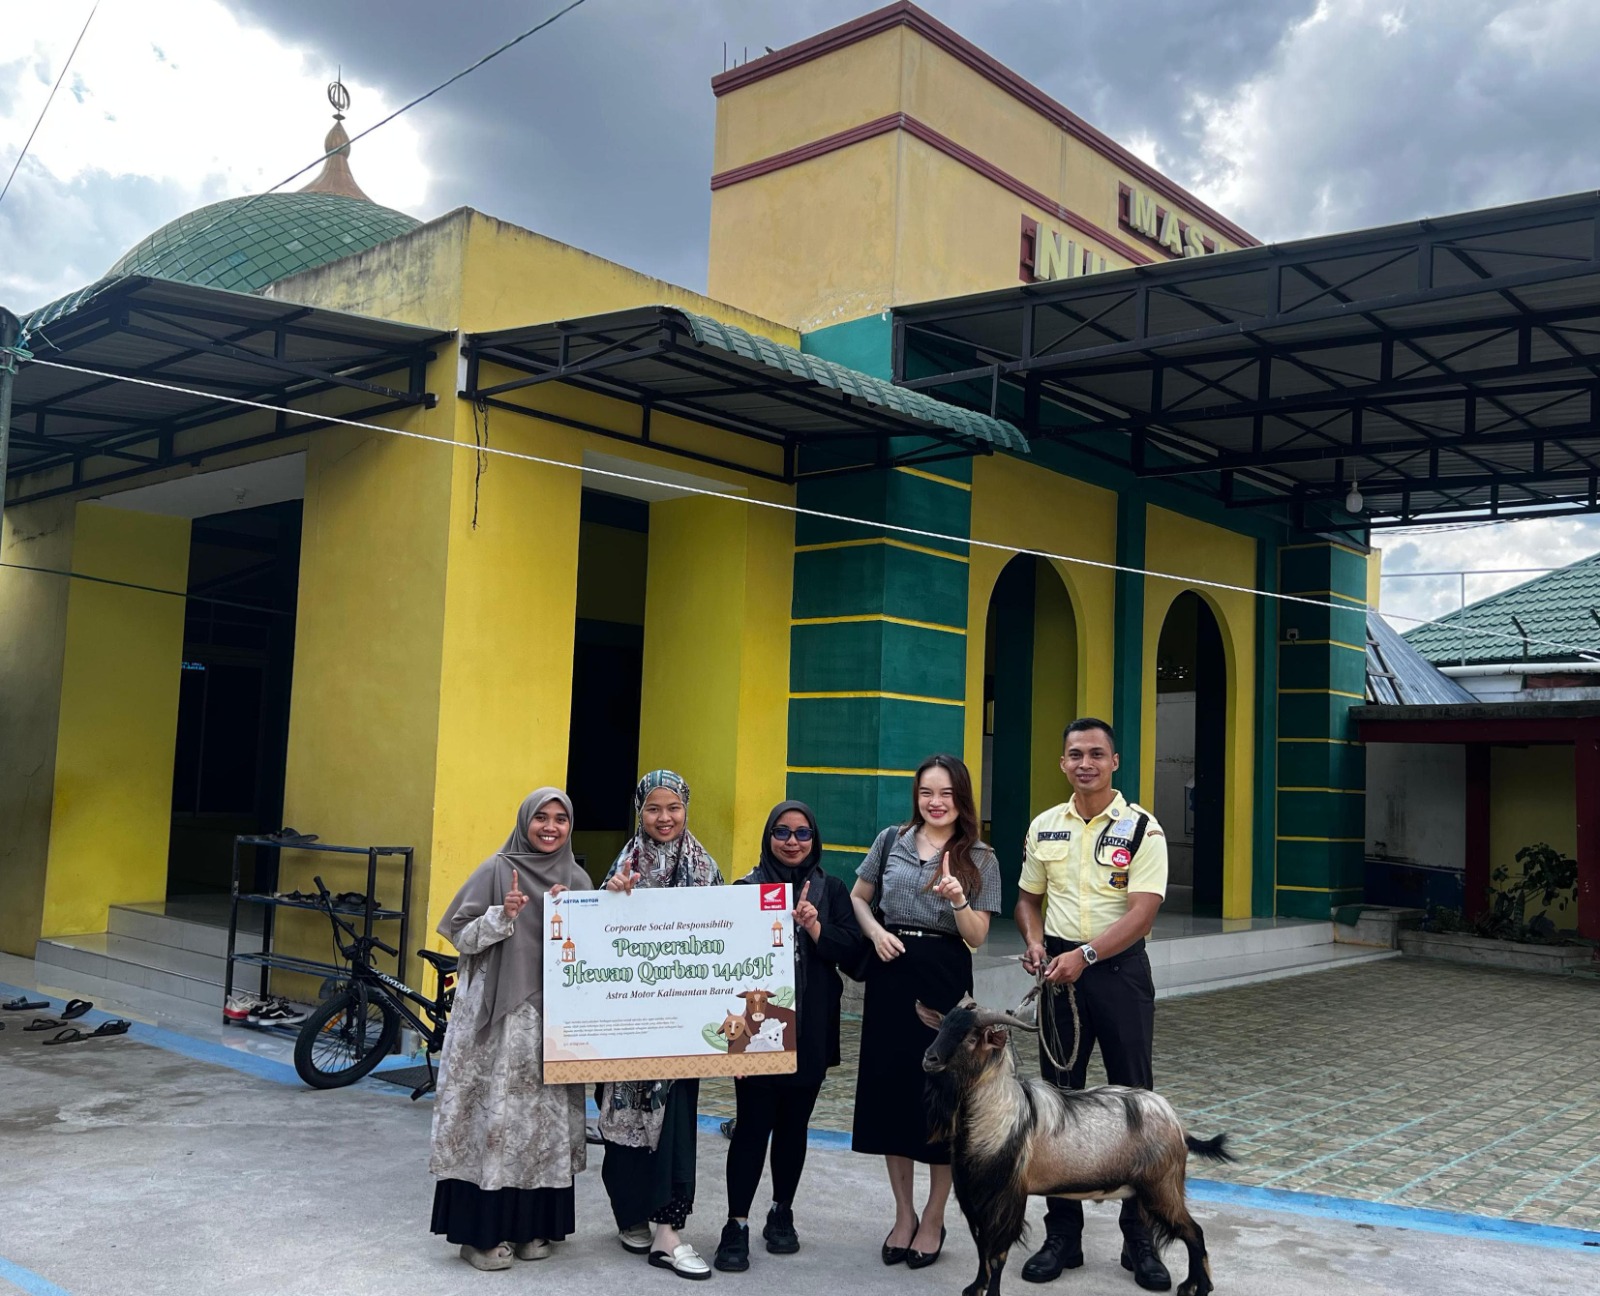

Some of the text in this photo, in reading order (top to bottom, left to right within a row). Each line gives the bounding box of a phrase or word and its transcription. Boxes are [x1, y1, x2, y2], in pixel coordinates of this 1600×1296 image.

[604, 919, 734, 934] Corporate Social Responsibility
[612, 935, 725, 960] Penyerahan
[562, 953, 776, 987] Hewan Qurban 1446H
[606, 986, 734, 1000] Astra Motor Kalimantan Barat
